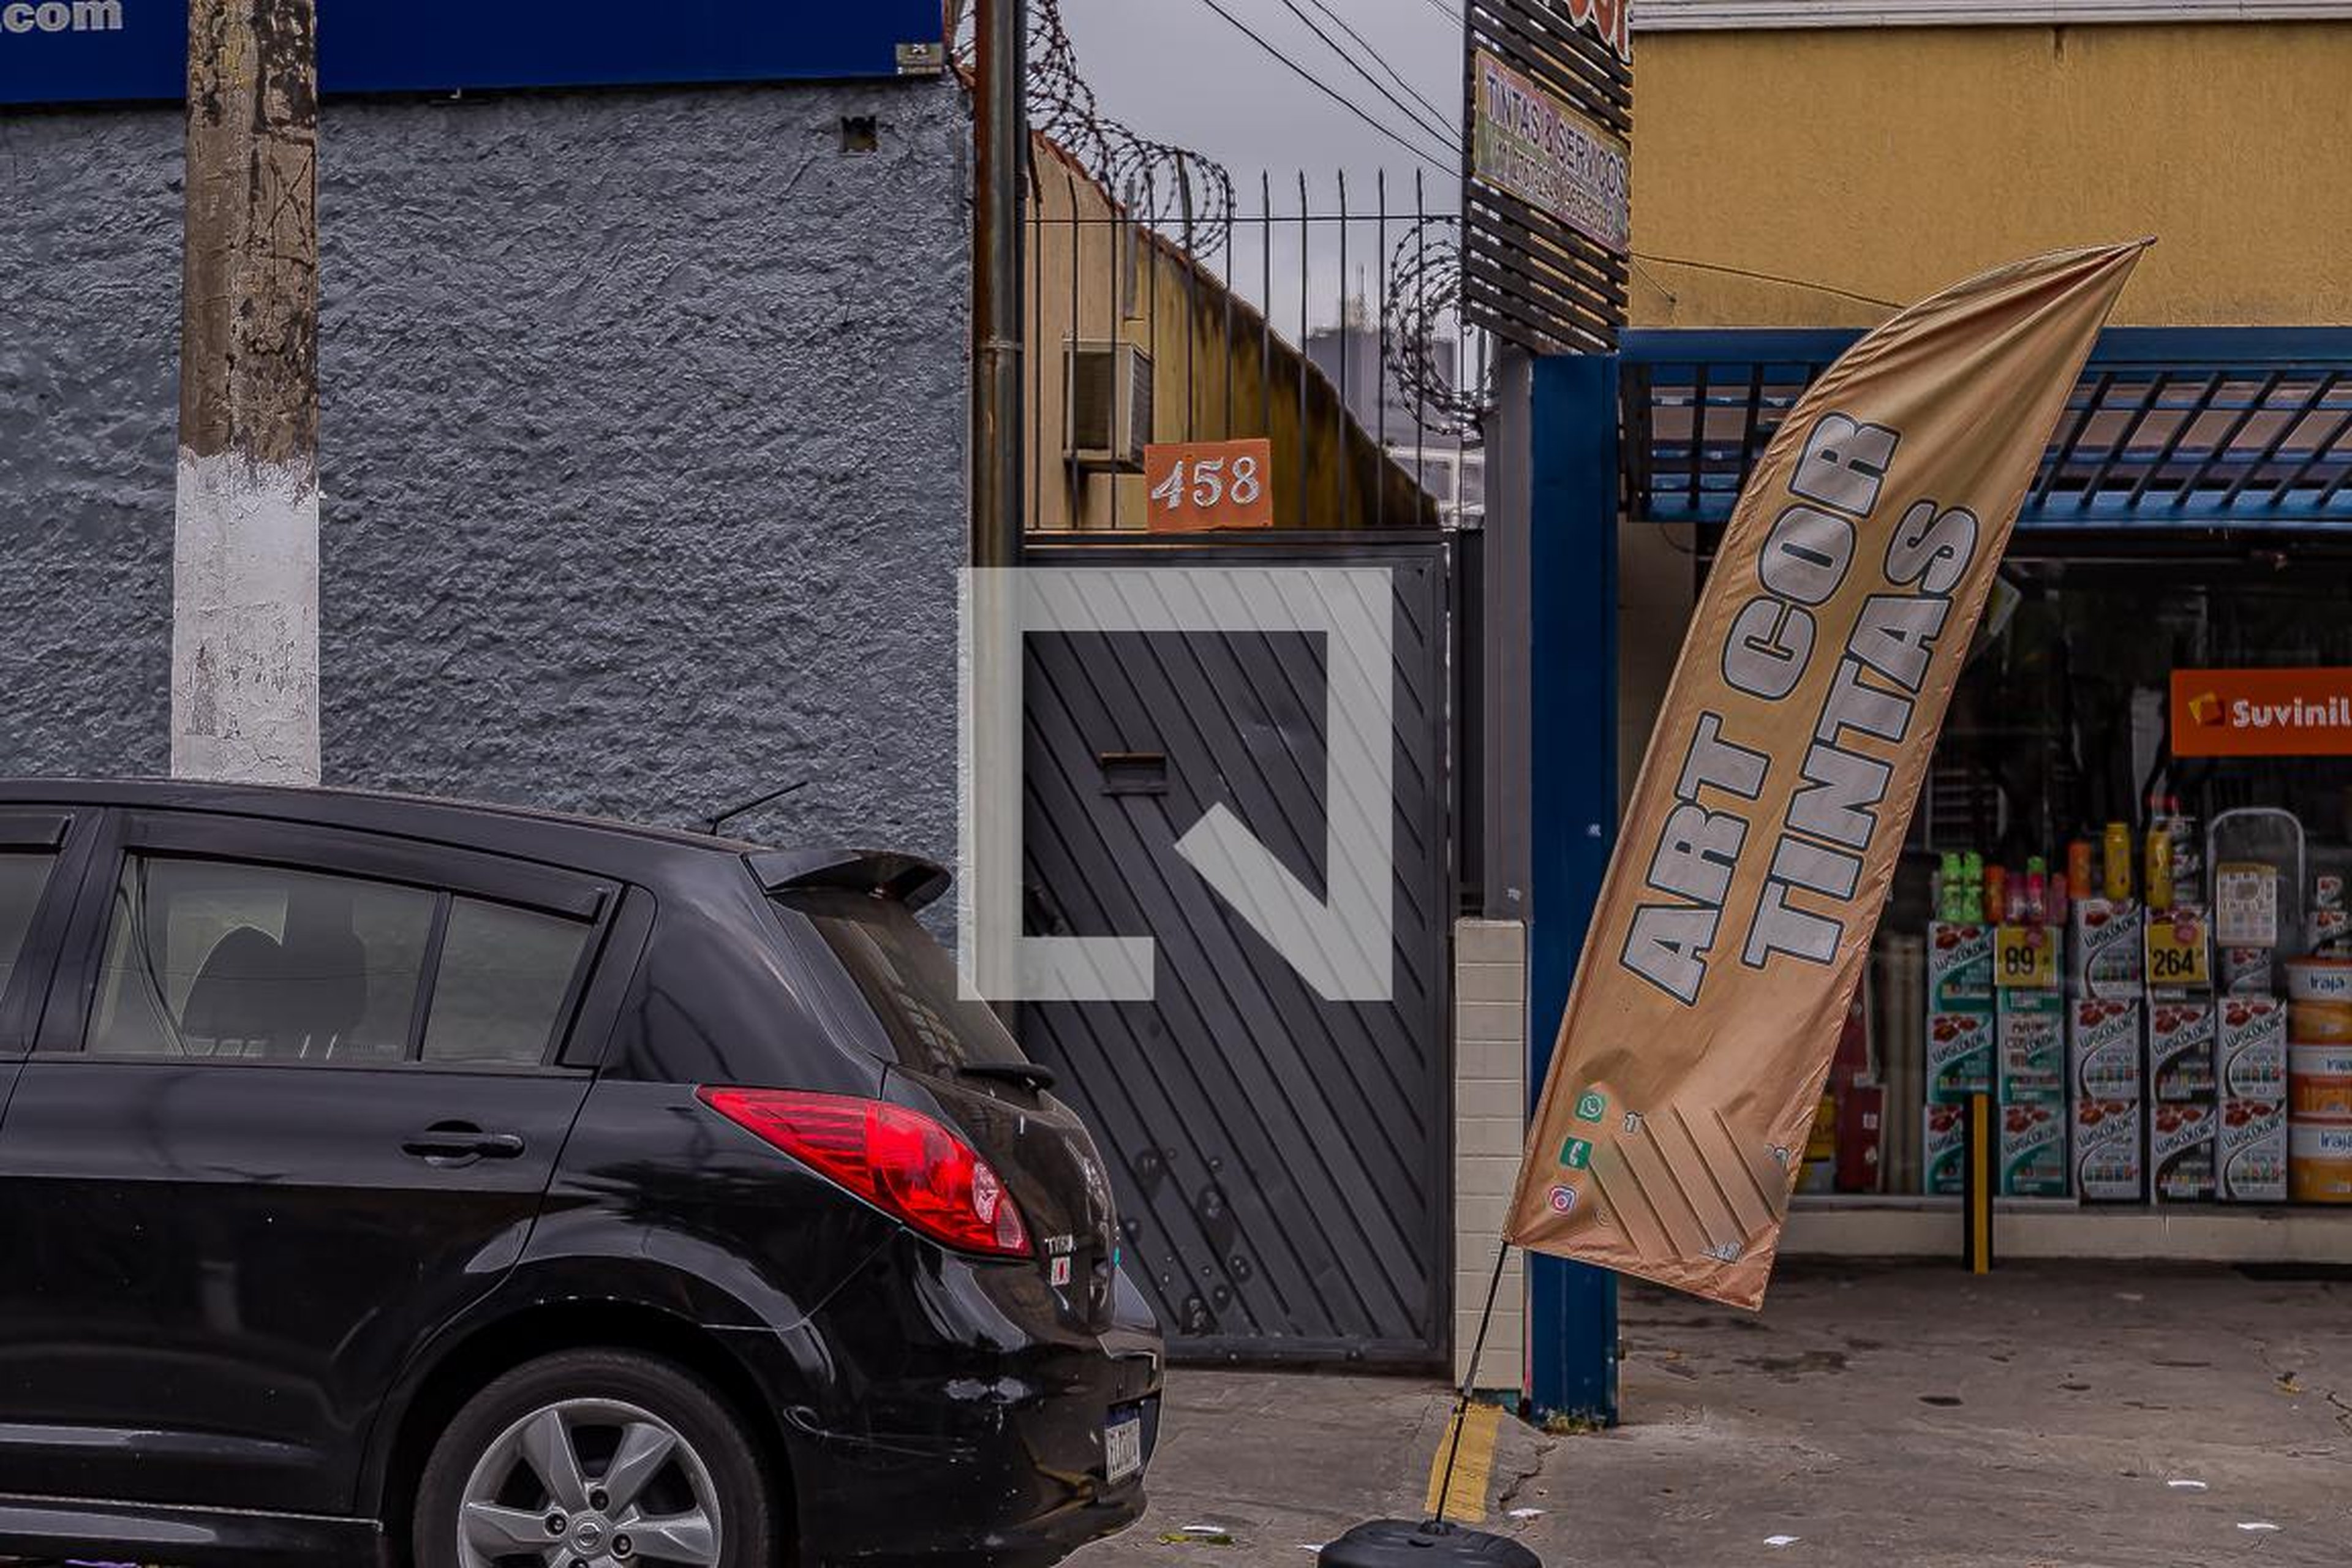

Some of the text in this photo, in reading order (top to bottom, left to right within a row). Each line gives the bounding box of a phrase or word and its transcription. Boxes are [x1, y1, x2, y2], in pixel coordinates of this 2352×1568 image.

[0, 0, 123, 32] com
[1152, 456, 1259, 509] 458
[1619, 411, 1902, 1006] ART COR
[2232, 696, 2352, 728] Suvinil
[1741, 499, 1978, 969] TINTAS
[2005, 947, 2034, 975] 89
[2153, 949, 2195, 977] 264
